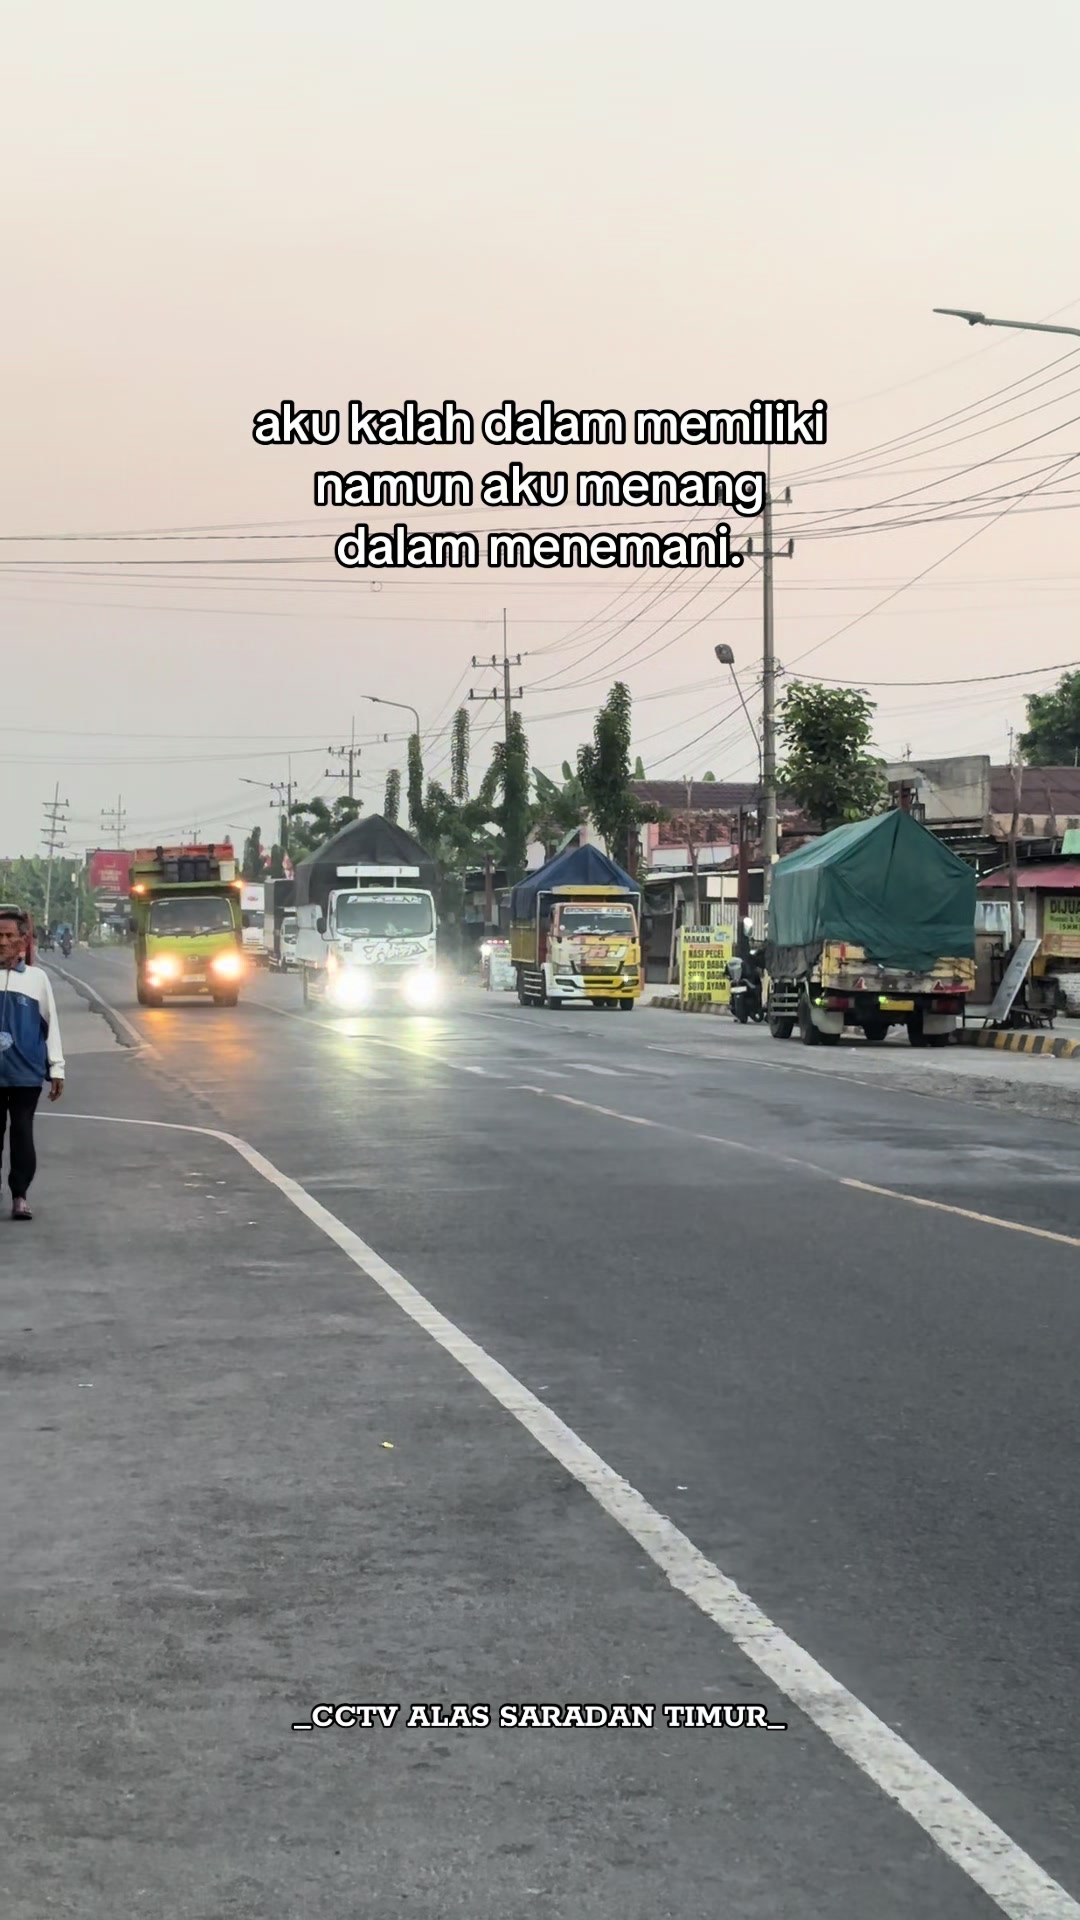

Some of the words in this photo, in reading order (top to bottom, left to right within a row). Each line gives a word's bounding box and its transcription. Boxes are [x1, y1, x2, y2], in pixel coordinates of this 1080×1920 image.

[684, 935, 711, 943] MAKAN
[689, 950, 704, 958] NASI
[705, 950, 724, 958] PECEL
[688, 961, 705, 969] SOTO
[688, 982, 705, 990] SOTO
[706, 982, 726, 990] AYAM
